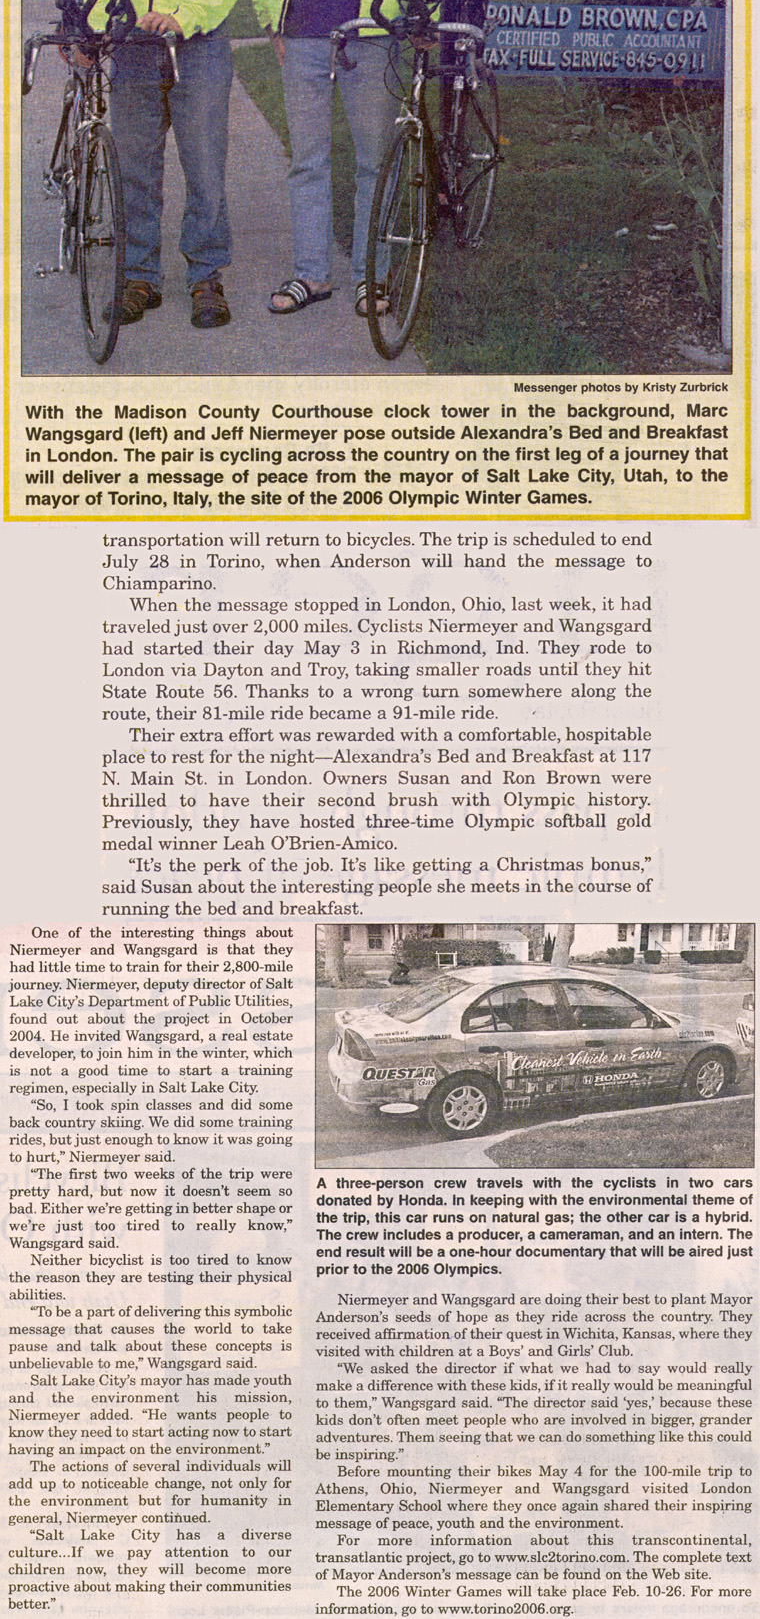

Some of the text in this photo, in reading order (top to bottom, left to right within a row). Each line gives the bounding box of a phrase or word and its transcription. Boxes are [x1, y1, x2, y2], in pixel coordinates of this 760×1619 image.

[486, 4, 572, 29] DONALD
[496, 30, 702, 49] CERTIFIED PUBLIC ACCOUNTANT
[514, 382, 728, 395] Messenger photos by Kristy Zurbrick
[25, 403, 728, 422] With the Madison County Courthouse clock tower in the background, Marc
[103, 705, 498, 723] route, their 81-mile ride became a 91-mile ride.
[102, 836, 397, 850] medal winner Leah O’Brien-Amico.
[511, 1055, 564, 1070] Cleanest
[567, 1050, 608, 1066] Vehicle
[630, 1046, 662, 1062] Earth
[362, 1066, 436, 1081] QUESTAR
[594, 1072, 639, 1082] HONDA
[10, 1081, 258, 1096] regimen, especially in Salt Lake City.
[418, 1078, 437, 1086] Gas
[316, 1263, 502, 1278] prior to the 2006 Olympics.
[8, 1511, 211, 1526] general, Niermeyer continued.
[315, 1603, 574, 1617] information, go to www.torino2006.org.
